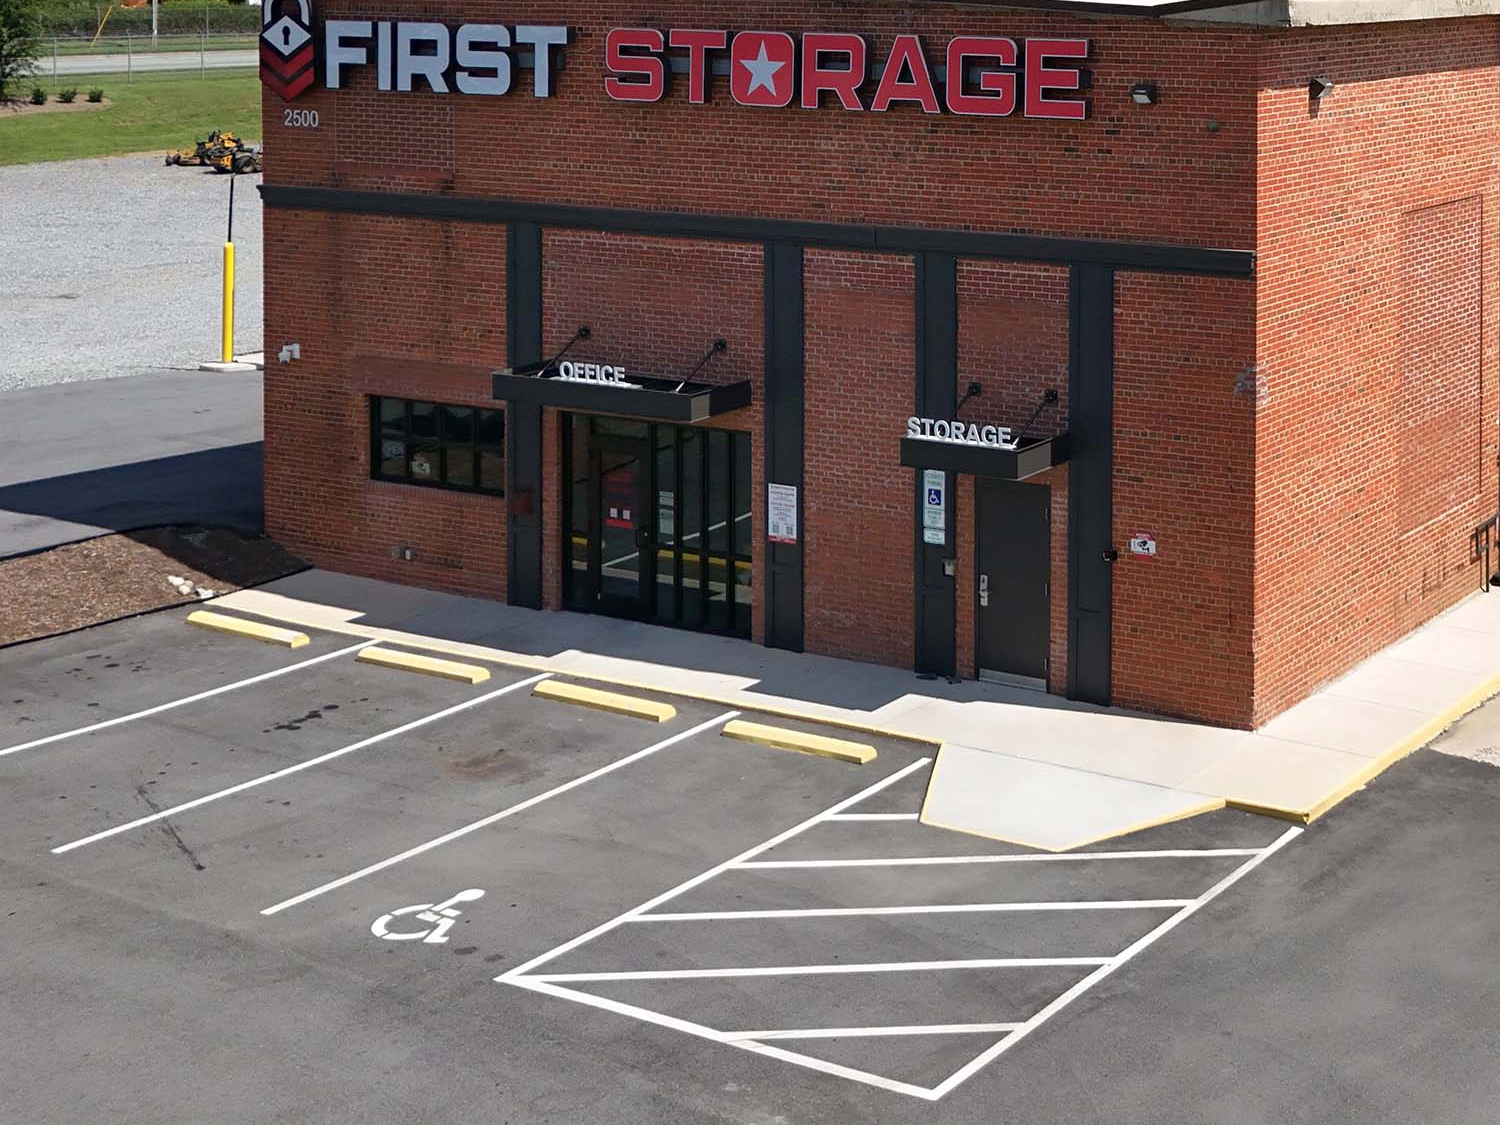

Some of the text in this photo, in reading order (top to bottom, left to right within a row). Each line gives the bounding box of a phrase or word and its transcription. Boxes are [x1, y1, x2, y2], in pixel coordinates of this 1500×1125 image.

[325, 20, 1089, 119] FIRST STORAGE
[284, 109, 319, 127] 2500
[559, 362, 625, 384] OFFICE
[907, 417, 1011, 446] STORAGE
